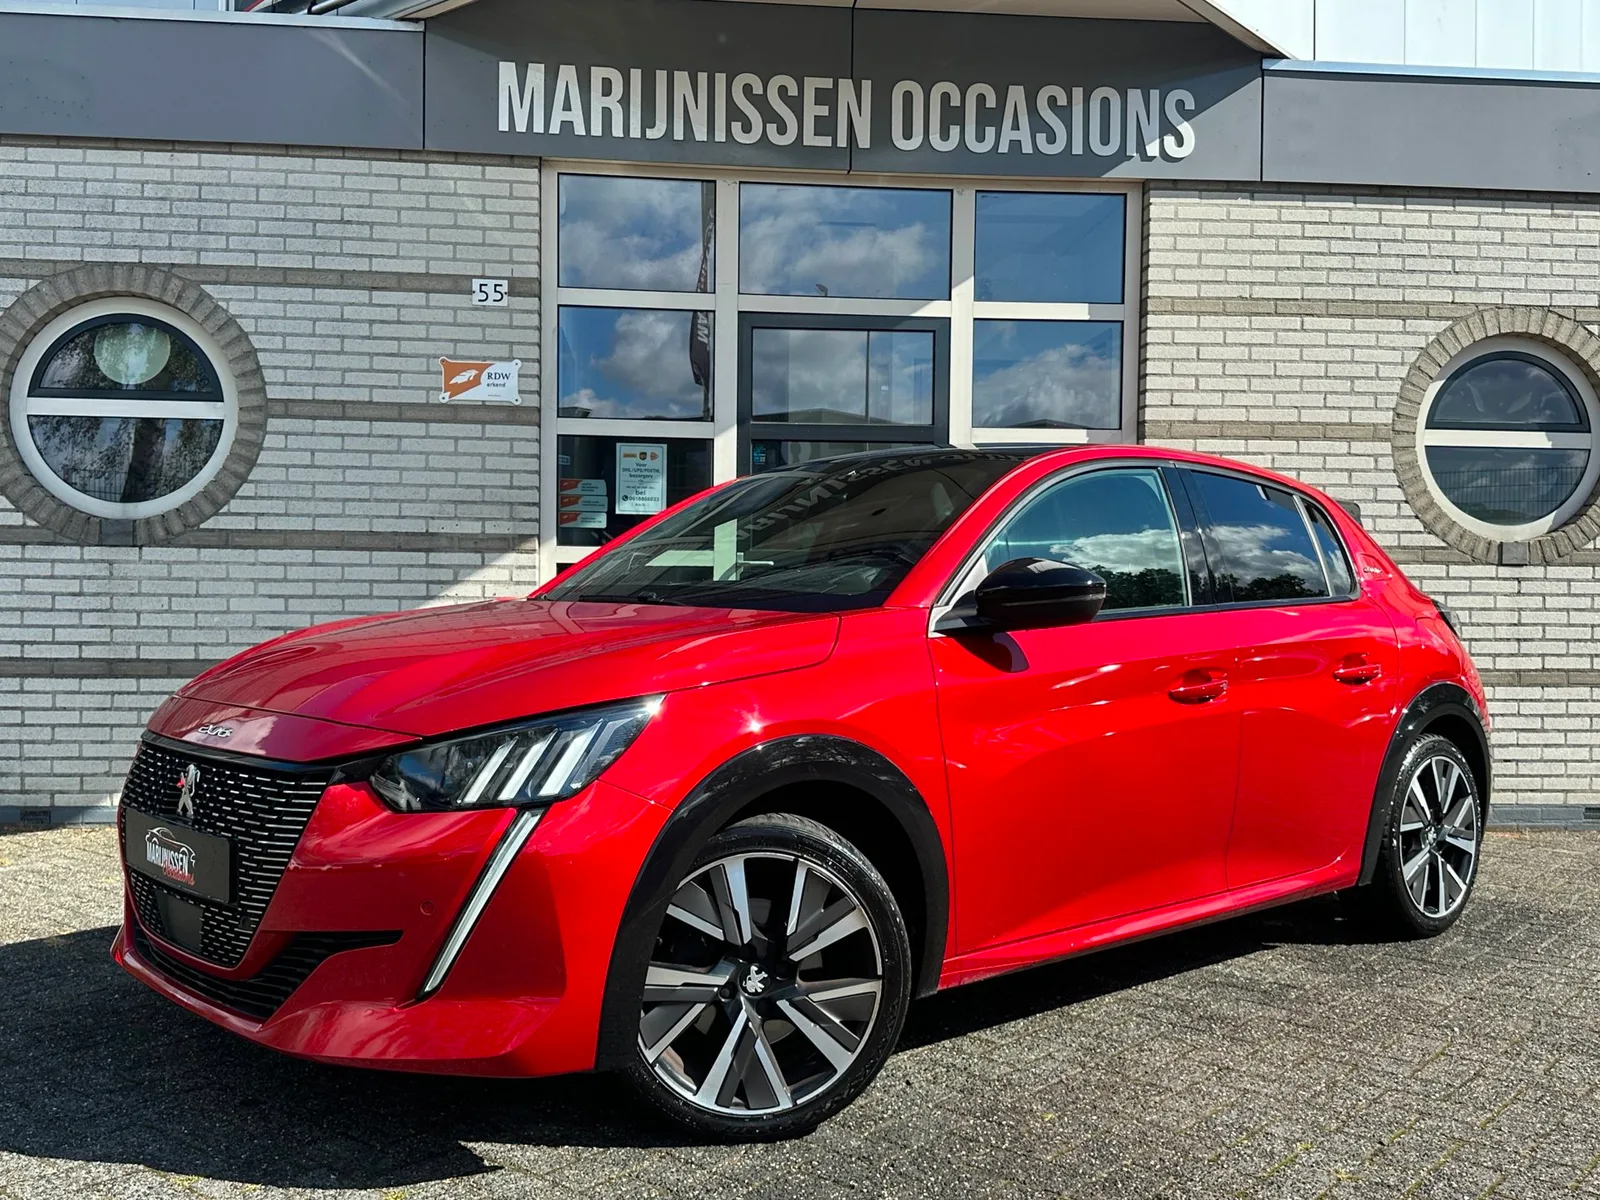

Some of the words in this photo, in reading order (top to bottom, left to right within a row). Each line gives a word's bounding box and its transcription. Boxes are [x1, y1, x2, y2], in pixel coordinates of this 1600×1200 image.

[498, 61, 872, 149] MARIJNISSEN
[890, 80, 1196, 159] OCCASIONS
[477, 283, 504, 303] 55
[486, 371, 512, 381] RDW
[486, 381, 507, 389] erkend
